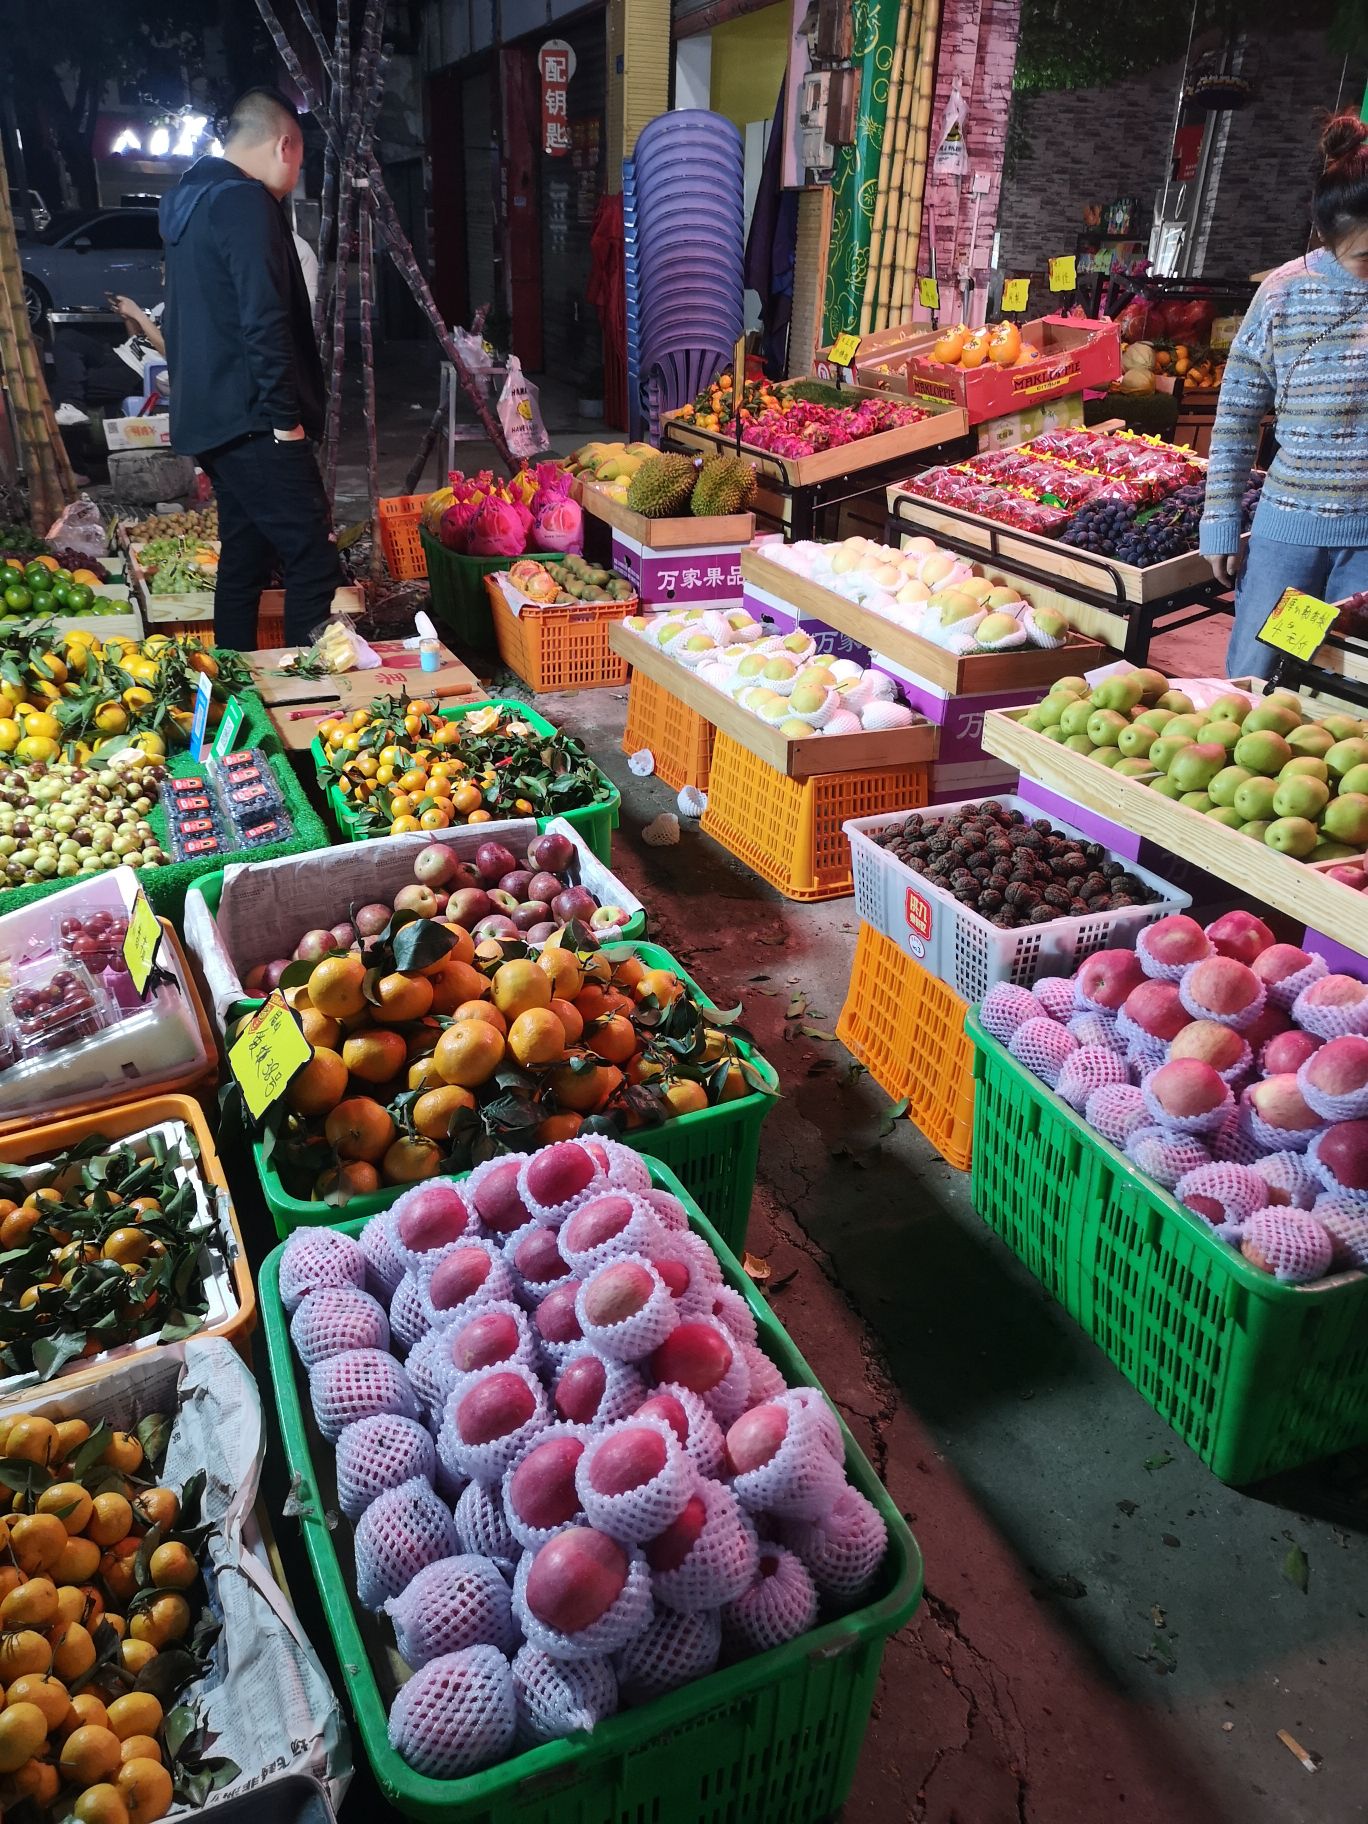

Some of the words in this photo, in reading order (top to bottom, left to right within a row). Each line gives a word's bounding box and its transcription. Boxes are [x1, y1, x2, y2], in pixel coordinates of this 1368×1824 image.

[545, 56, 567, 149] 配钥匙
[657, 565, 746, 591] 万家果品
[956, 712, 985, 739] 万
